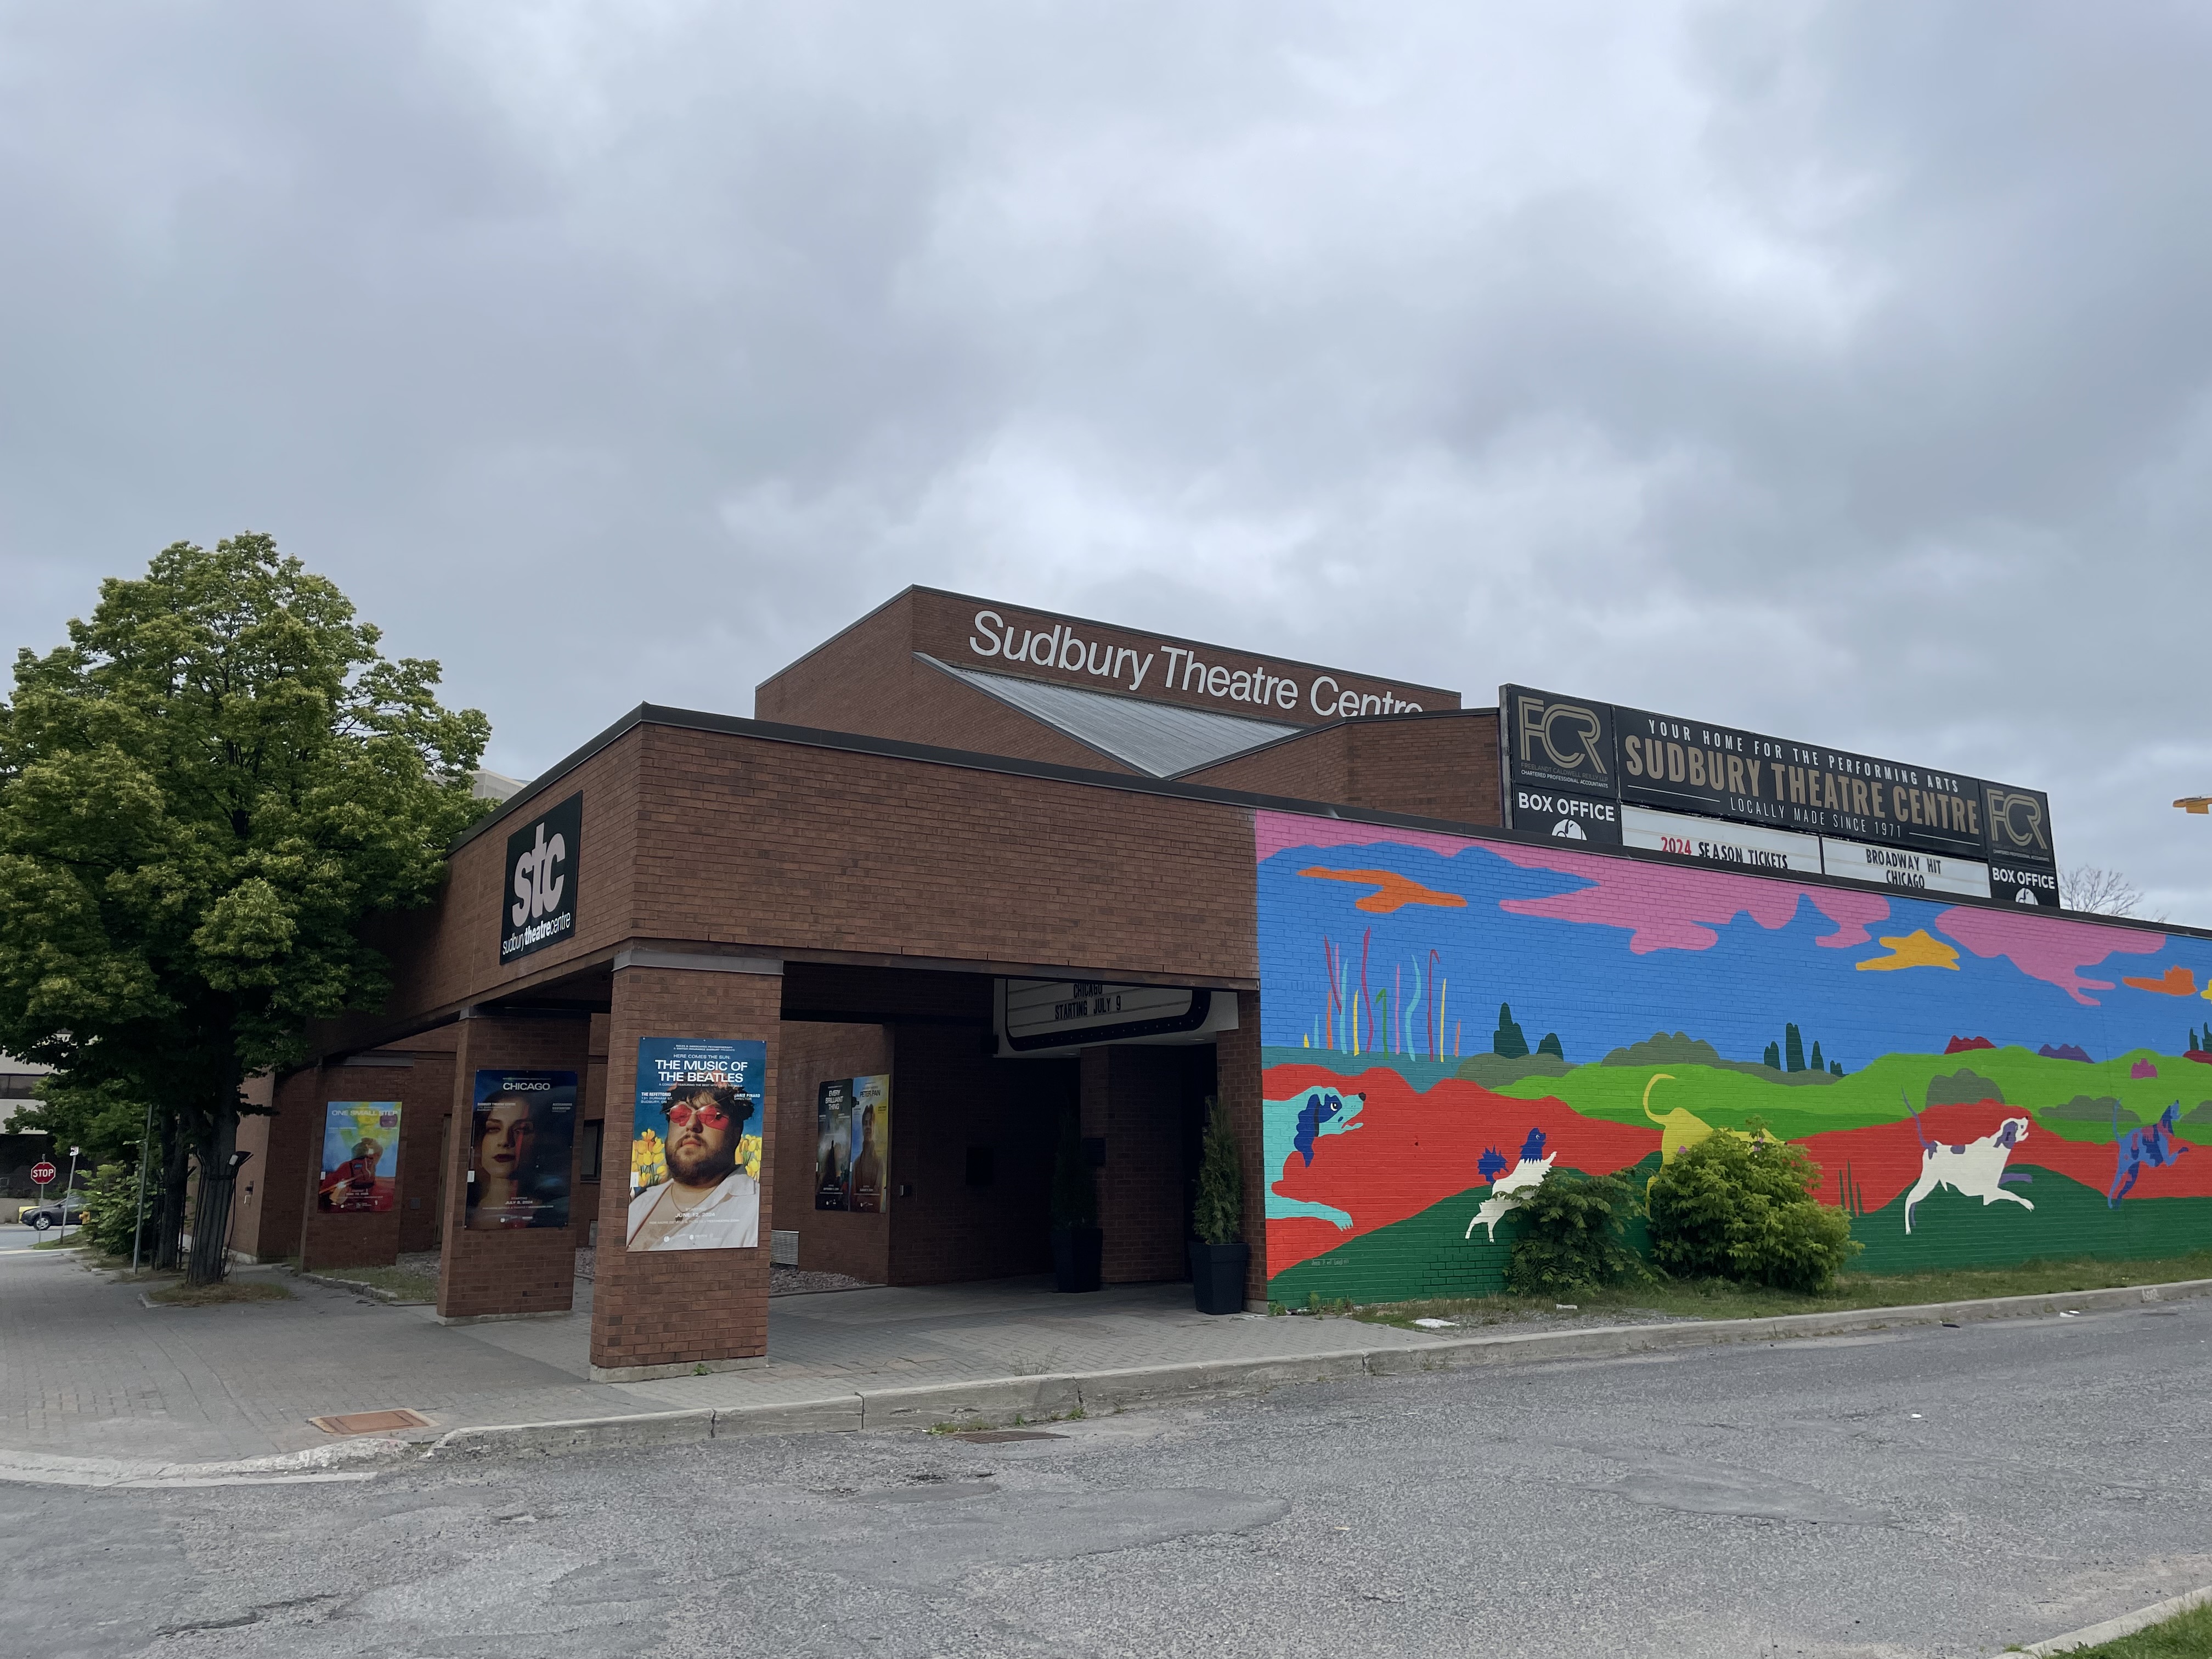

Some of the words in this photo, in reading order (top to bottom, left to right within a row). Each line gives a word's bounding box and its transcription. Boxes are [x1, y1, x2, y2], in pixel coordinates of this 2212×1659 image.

[969, 610, 1155, 691] Sudbury
[1159, 645, 1299, 710] Theatre
[1518, 695, 1607, 774] FCR
[1648, 719, 1691, 741] YOUR
[1702, 730, 1743, 752] HOME
[1754, 741, 1782, 759] FOR
[1792, 748, 1819, 766] THE
[1828, 755, 1917, 786] PERFORMING
[1927, 775, 1959, 793] ARTS
[1521, 769, 1547, 778] CHARTERED
[1547, 774, 1579, 784] PROFESSIONAL
[1579, 780, 1609, 789] ACCOUNTANTS
[1553, 768, 1582, 778] CALDWELL
[1625, 735, 1760, 797] SUDBURY
[1770, 763, 1886, 819] THEATRE
[1892, 786, 1980, 834] CENTRE
[1518, 792, 1554, 813] BOX
[1556, 798, 1615, 822] OFFICE
[1730, 797, 1785, 819] LOCALLY
[1794, 807, 1825, 826] MADE
[1833, 814, 1866, 833] SINCE
[1874, 821, 1901, 838] 1971
[1986, 788, 2048, 850] FCR
[1661, 837, 1692, 855] 2024
[1699, 842, 1743, 863] SEASON
[1748, 849, 1788, 869] TICKETS
[1865, 849, 1920, 871] BROADWAY
[1926, 858, 1941, 874] HIT
[512, 822, 566, 927] stc
[1886, 870, 1925, 889] CHICAGO
[1991, 867, 2016, 884] BOX
[2017, 871, 2056, 890] OFFICE
[1073, 983, 1103, 998] CHICAGO
[1055, 1000, 1088, 1019] STARTING
[1093, 997, 1111, 1014] JULY
[1116, 995, 1121, 1011] 9
[654, 1059, 681, 1070] THE
[684, 1060, 729, 1071] MUSIC
[730, 1061, 748, 1071] OF
[658, 1071, 684, 1082] THE
[687, 1072, 743, 1083] BEATLES
[503, 1082, 551, 1091] CHICAGO
[32, 1169, 54, 1178] STOP
